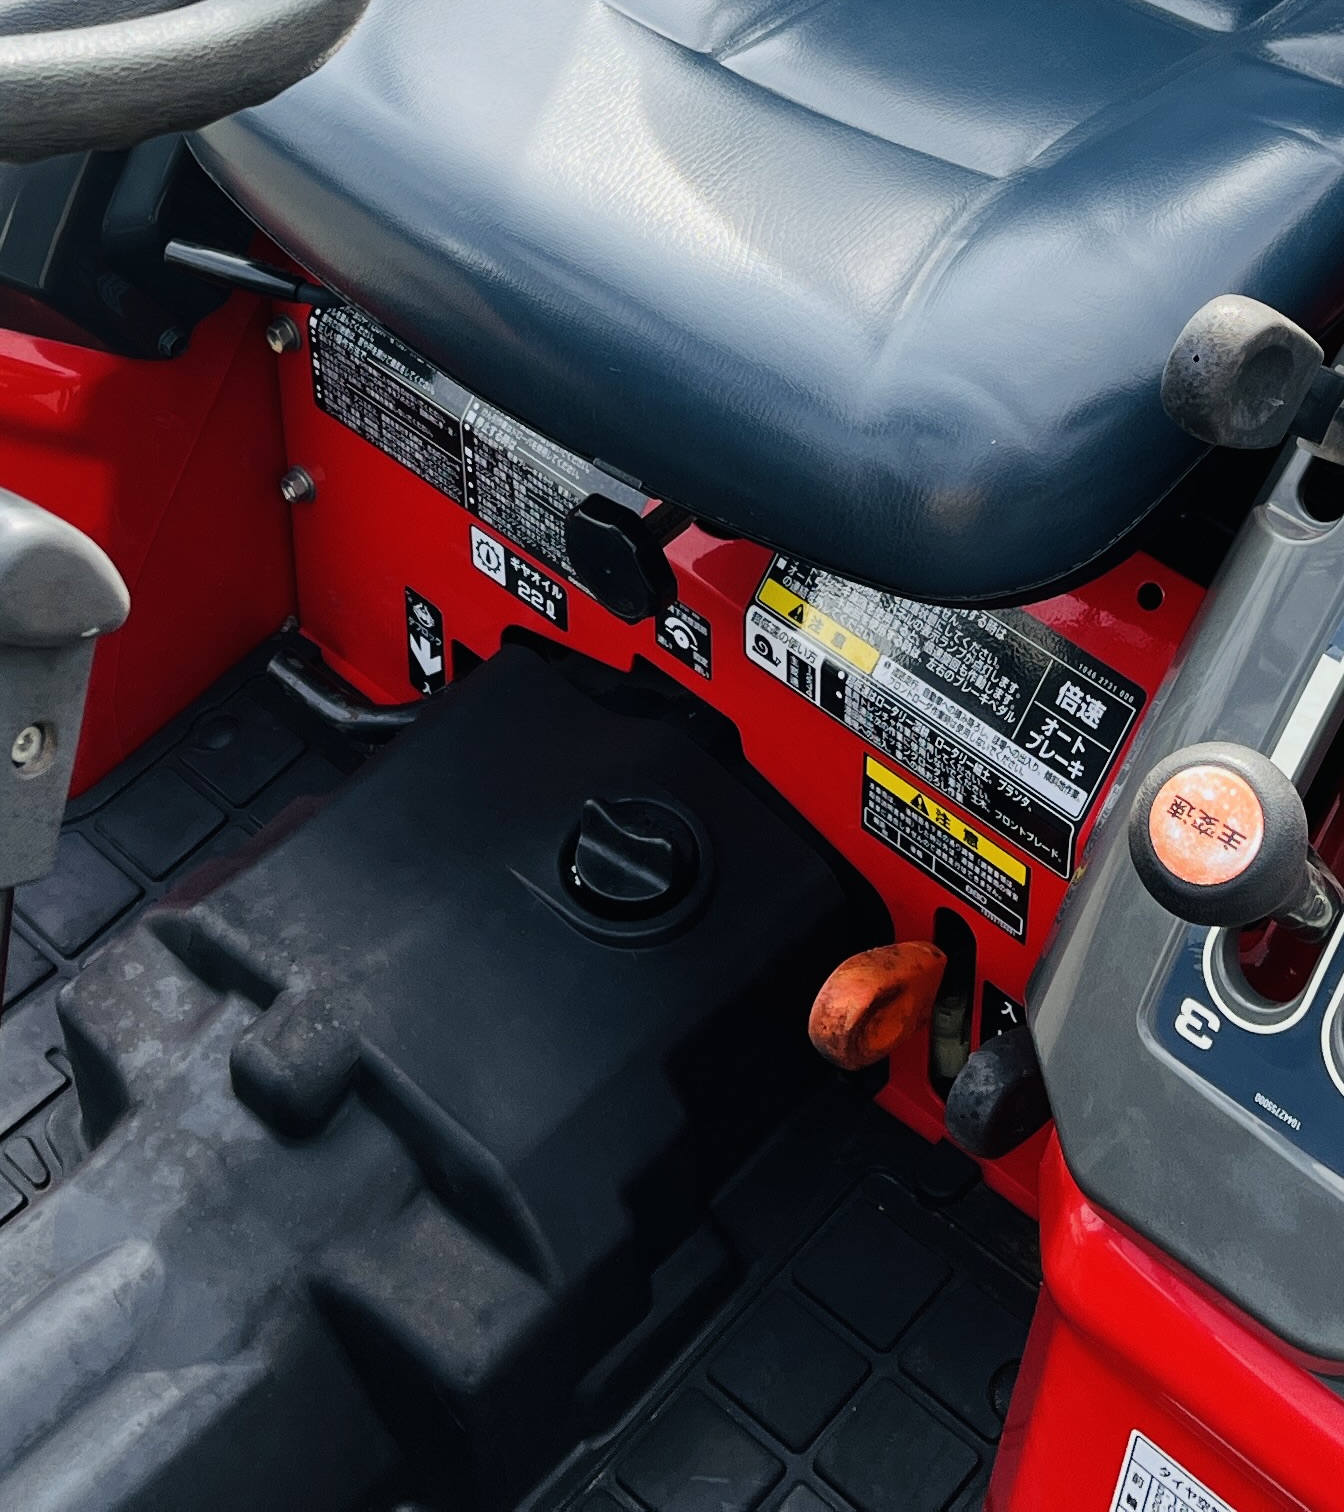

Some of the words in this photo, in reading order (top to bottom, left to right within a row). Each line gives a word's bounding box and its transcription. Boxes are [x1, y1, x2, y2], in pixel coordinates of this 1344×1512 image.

[1055, 680, 1107, 730] 倍速
[1025, 730, 1085, 780] ブレーキ
[1041, 717, 1086, 754] オート
[1165, 794, 1249, 855] 主変速
[1173, 996, 1222, 1053] 3
